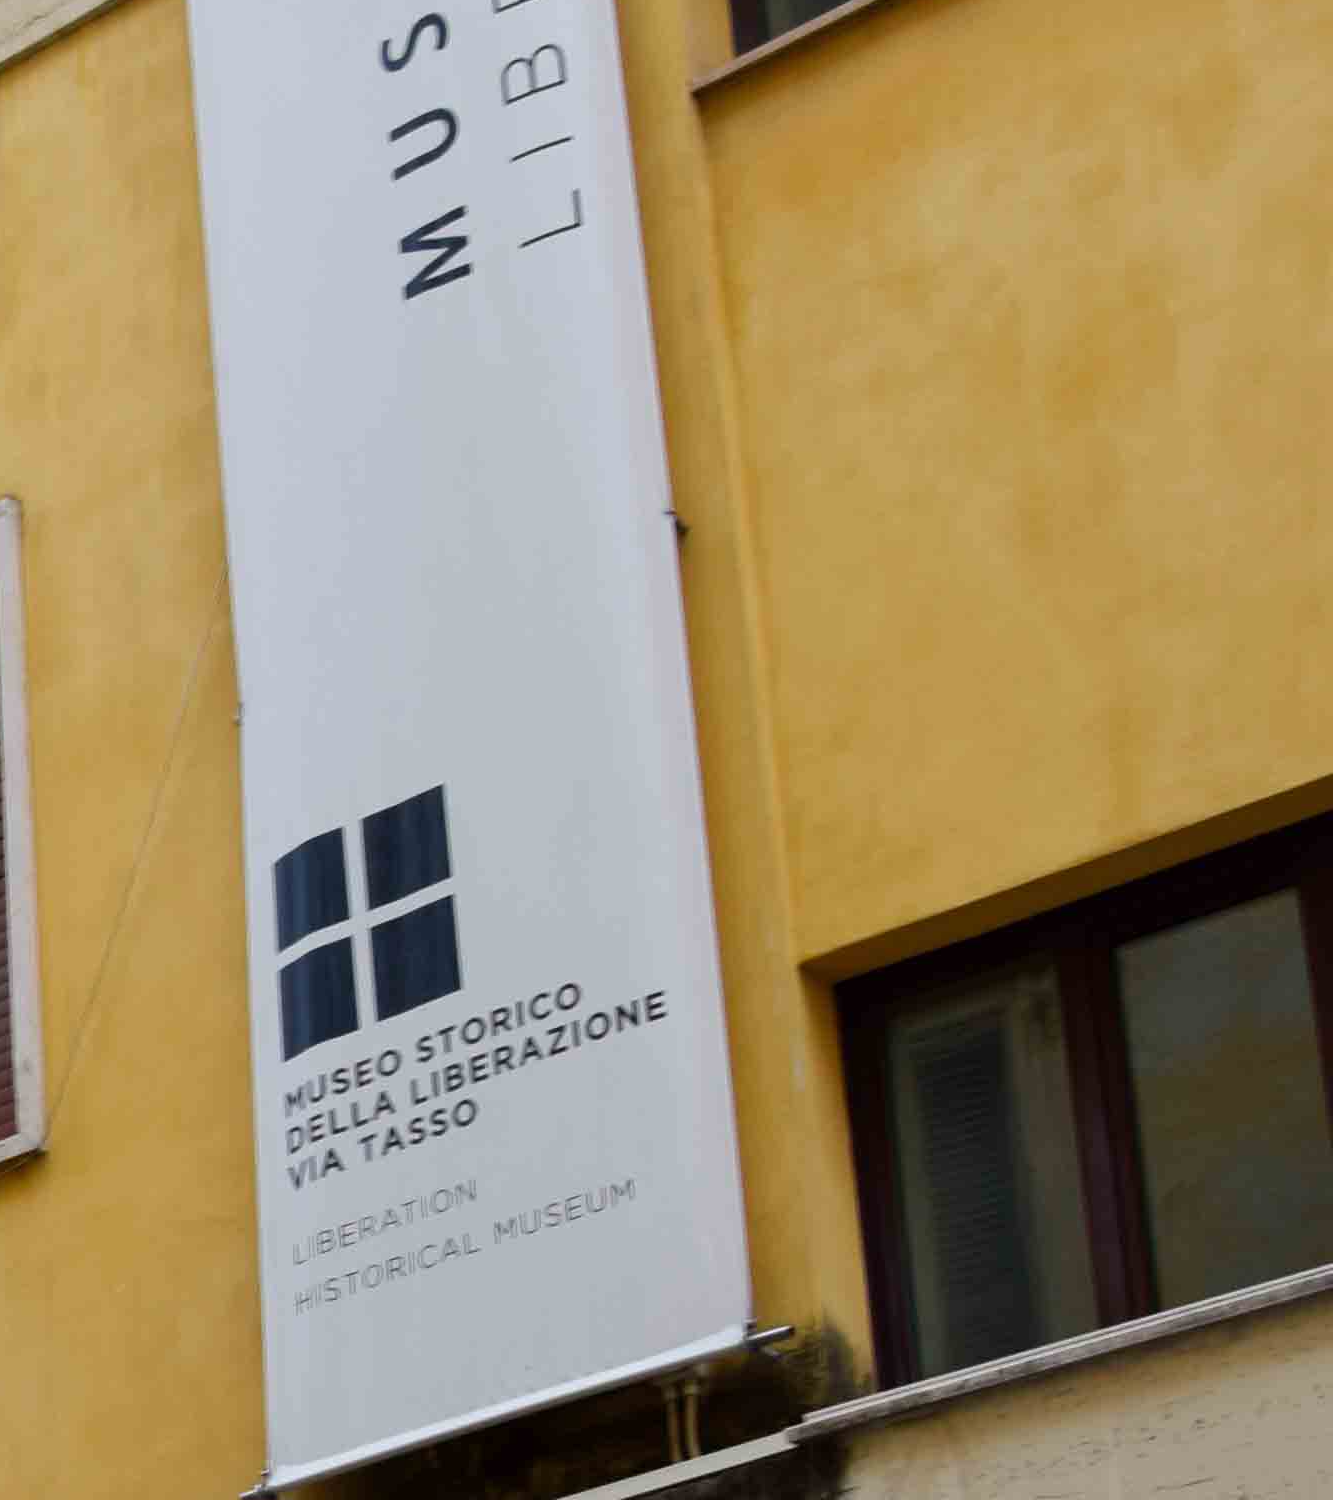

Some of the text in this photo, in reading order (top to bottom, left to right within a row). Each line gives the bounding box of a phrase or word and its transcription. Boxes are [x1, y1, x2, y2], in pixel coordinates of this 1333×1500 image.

[284, 981, 583, 1117] MUSEO STORICO
[285, 989, 668, 1156] DELLA LIBERAZIONE
[286, 1098, 479, 1191] VIA TASSO
[291, 1179, 478, 1267] LIBERATION
[293, 1178, 637, 1317] HISTORICAL MUSEUM
